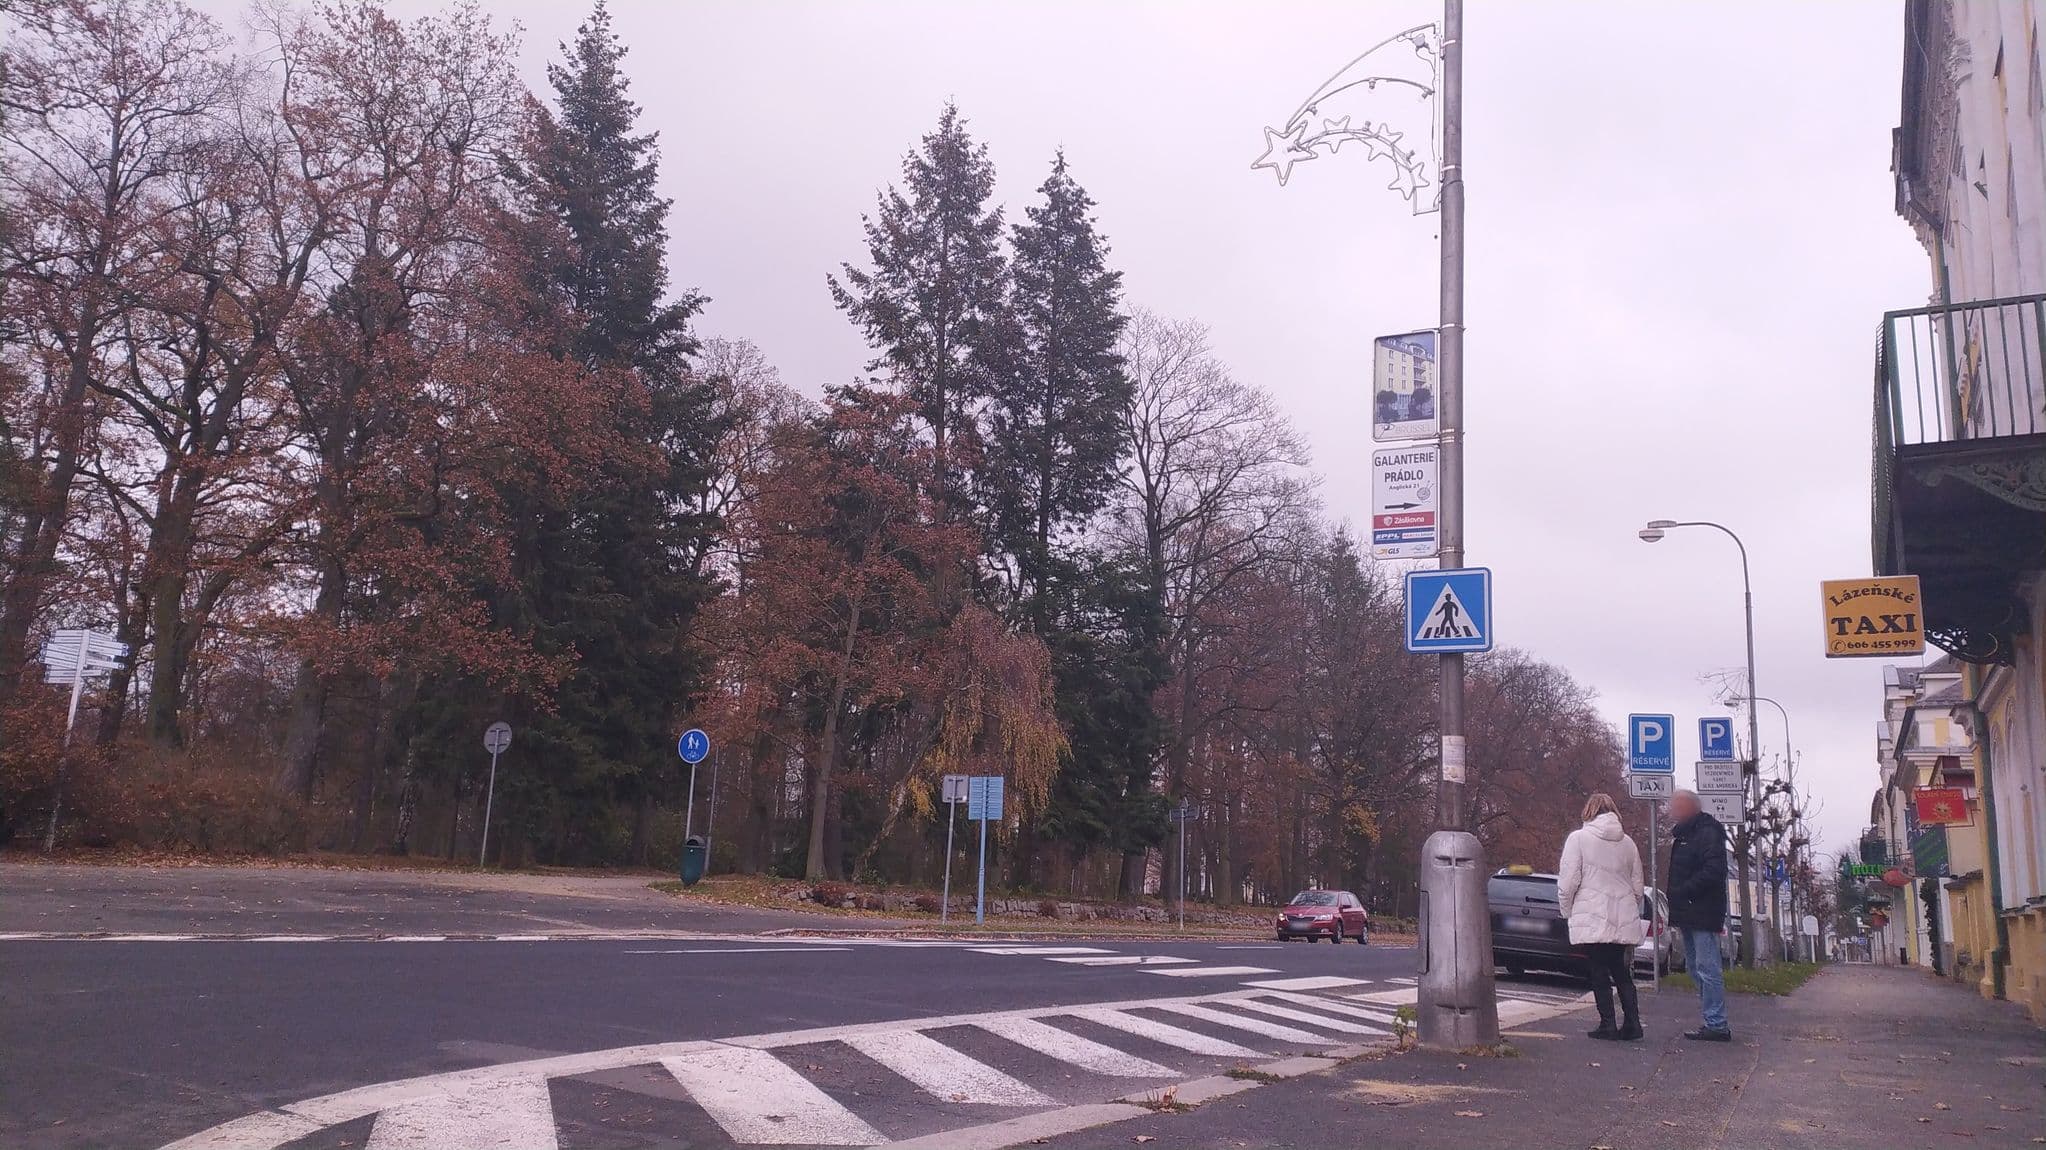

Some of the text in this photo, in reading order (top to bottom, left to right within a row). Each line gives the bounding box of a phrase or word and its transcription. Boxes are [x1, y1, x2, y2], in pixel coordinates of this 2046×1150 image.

[1374, 452, 1435, 467] GALANTERIE
[1384, 468, 1424, 482] PRÁDLO
[1829, 583, 1915, 607] Lázeňské
[1831, 613, 1917, 636] TAXI
[1847, 640, 1917, 649] 606 455 999
[1638, 721, 1663, 753] P
[1706, 723, 1725, 747] P
[1633, 756, 1670, 766] RÉSERVÉ
[1637, 781, 1665, 792] TAXI
